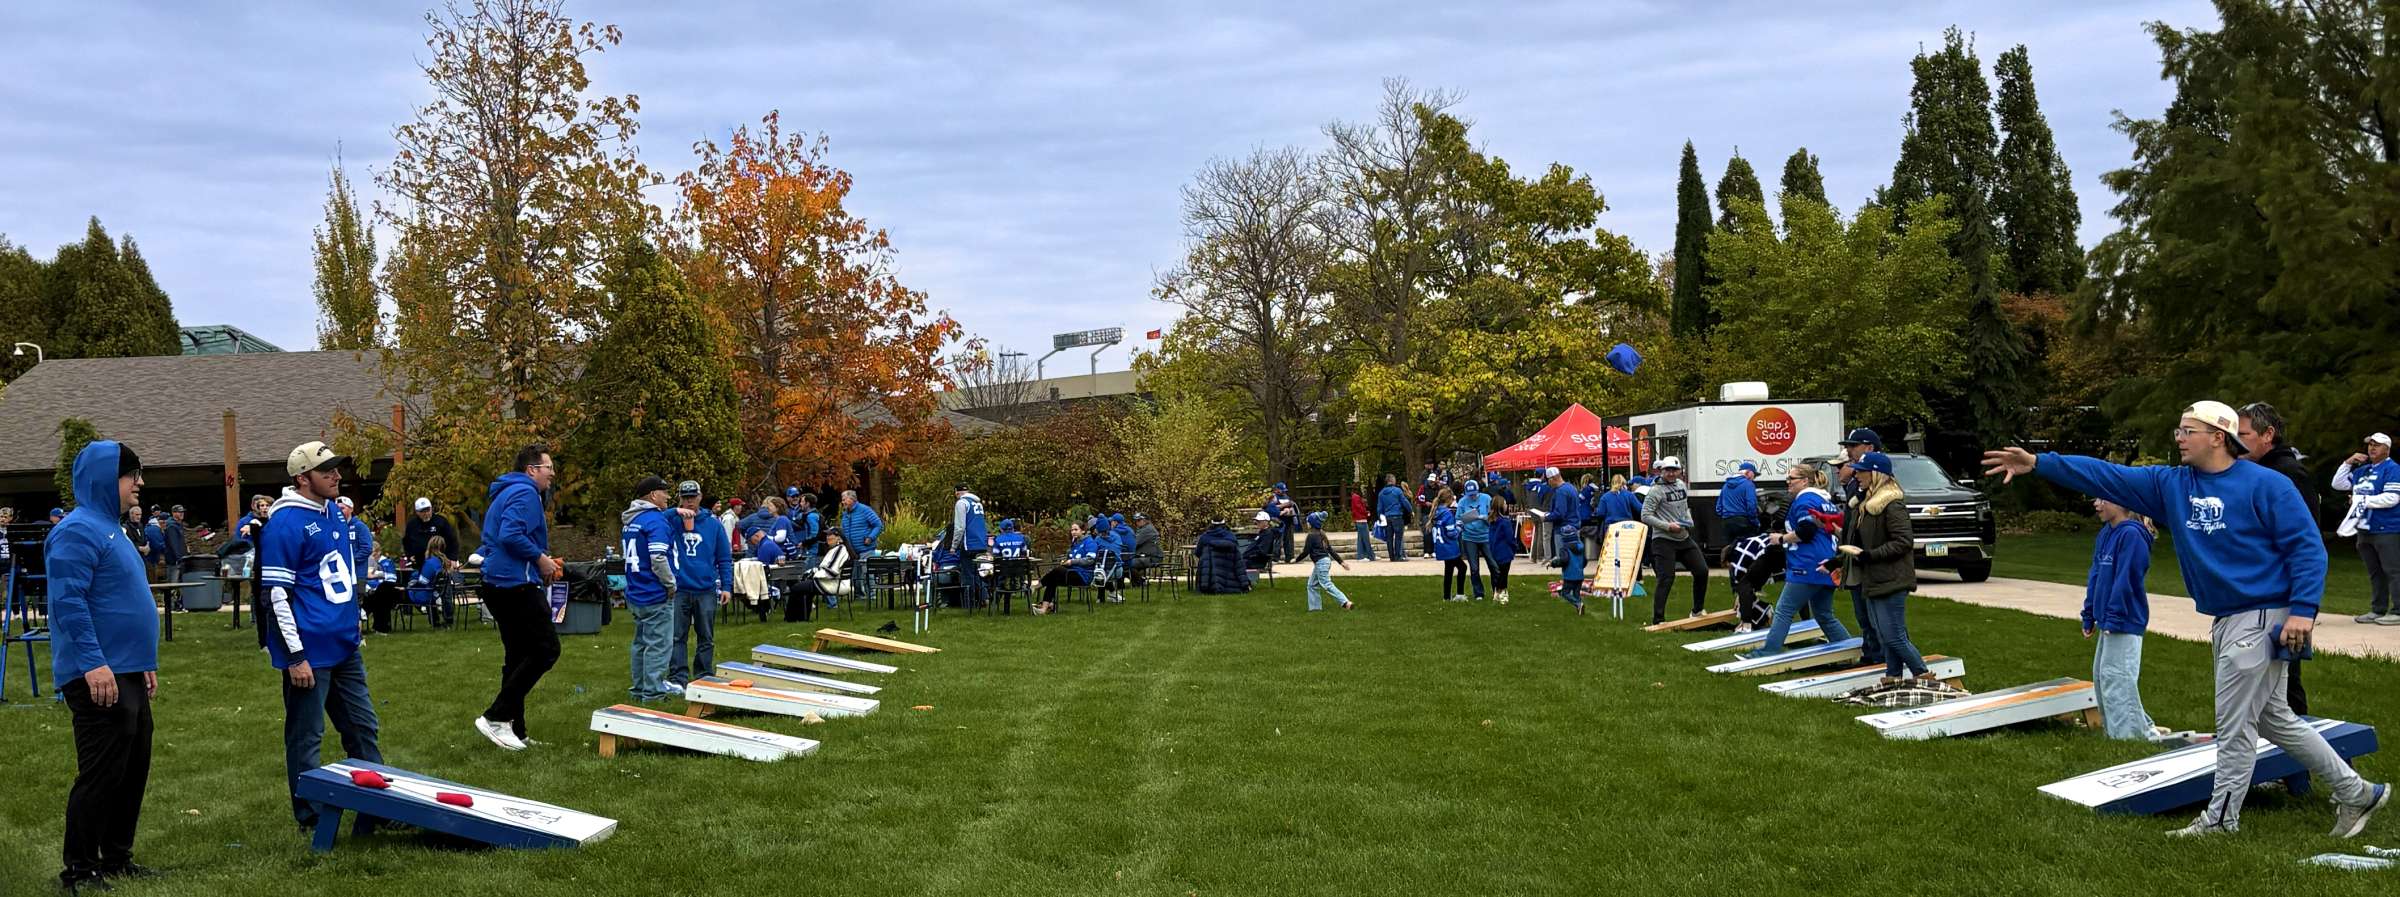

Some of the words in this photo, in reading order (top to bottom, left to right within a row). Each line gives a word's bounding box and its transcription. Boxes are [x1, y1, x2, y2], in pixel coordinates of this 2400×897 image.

[1756, 419, 1782, 431] Slap
[1761, 430, 1790, 440] Soda
[2191, 501, 2224, 522] BYU
